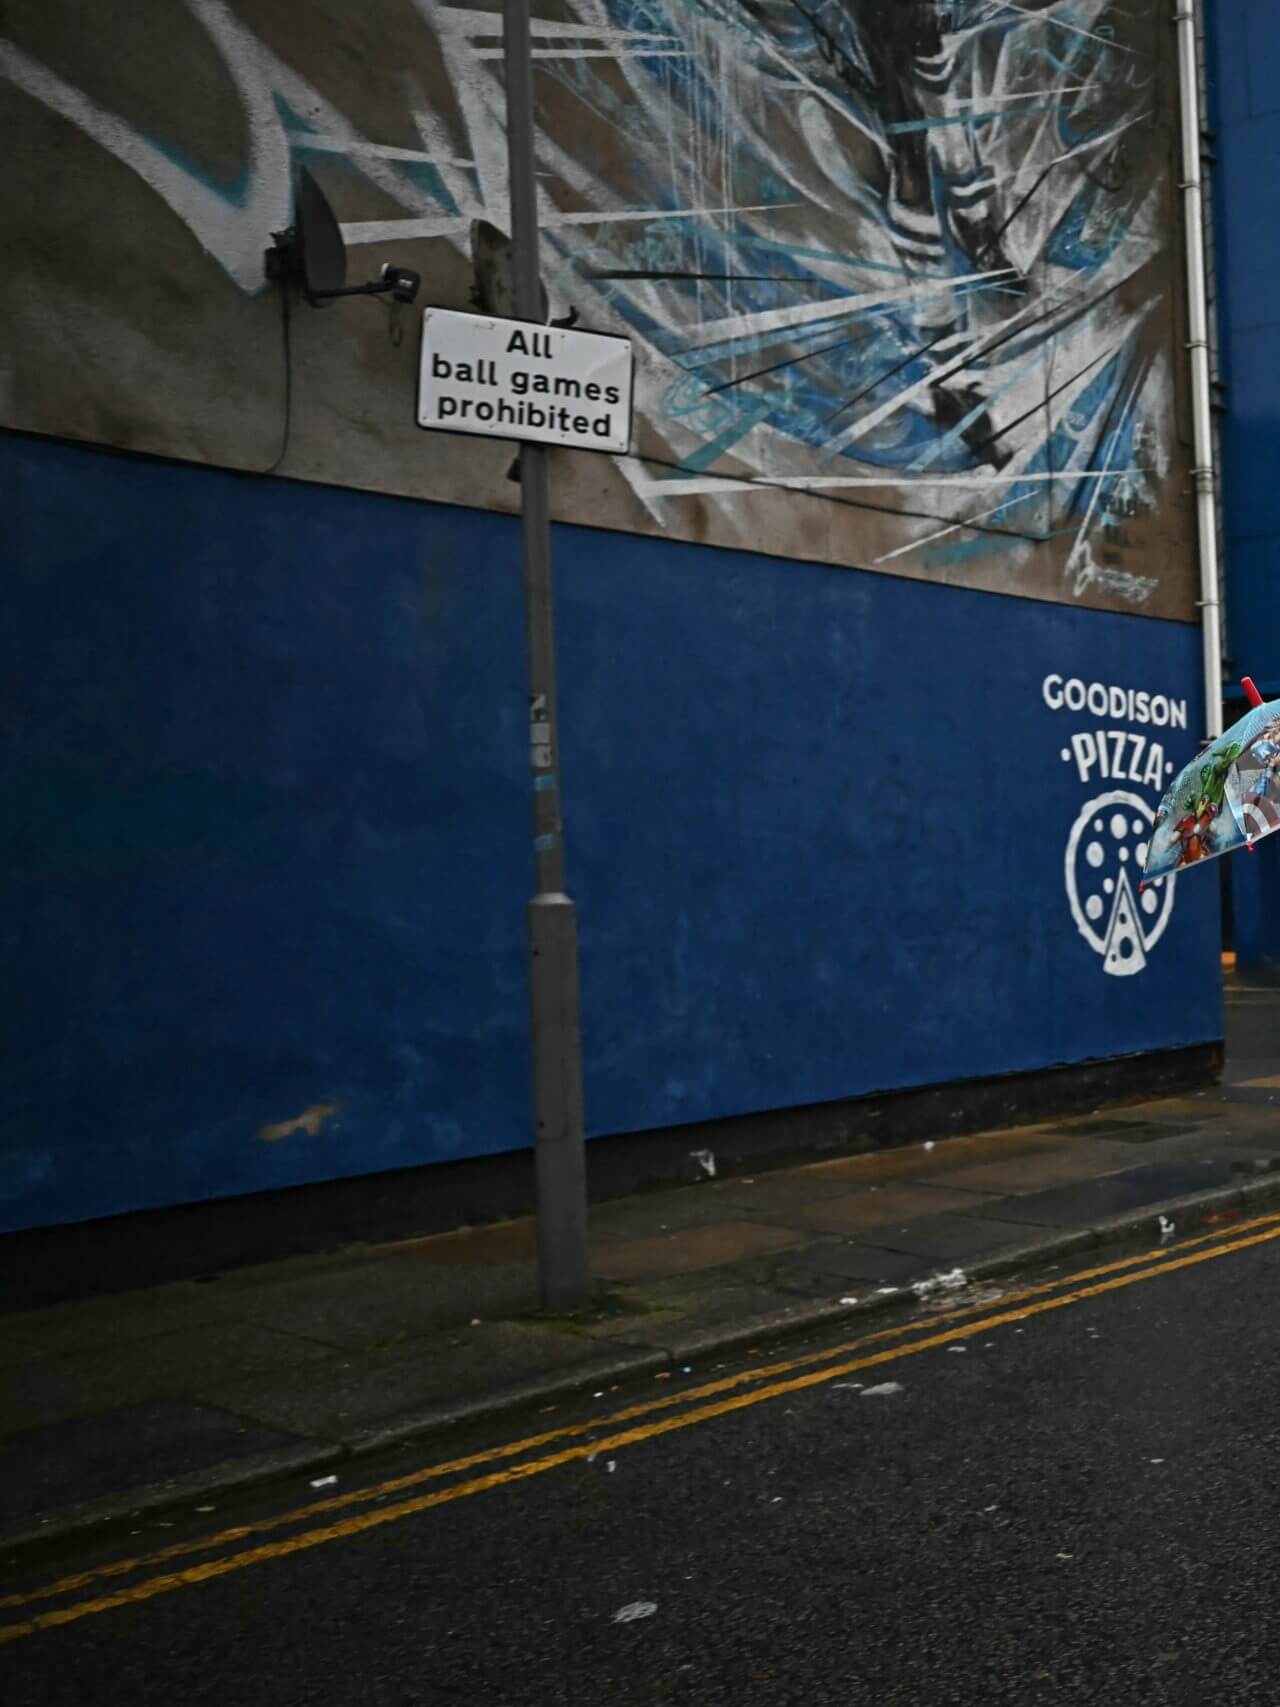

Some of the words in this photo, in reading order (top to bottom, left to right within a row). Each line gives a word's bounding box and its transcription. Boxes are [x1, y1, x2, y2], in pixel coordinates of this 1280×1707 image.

[506, 329, 553, 359] All
[431, 353, 498, 386] ball
[511, 371, 620, 405] games
[437, 396, 612, 437] prohibited
[1042, 674, 1187, 729] GOODISON
[1071, 730, 1165, 792] PIZZA
